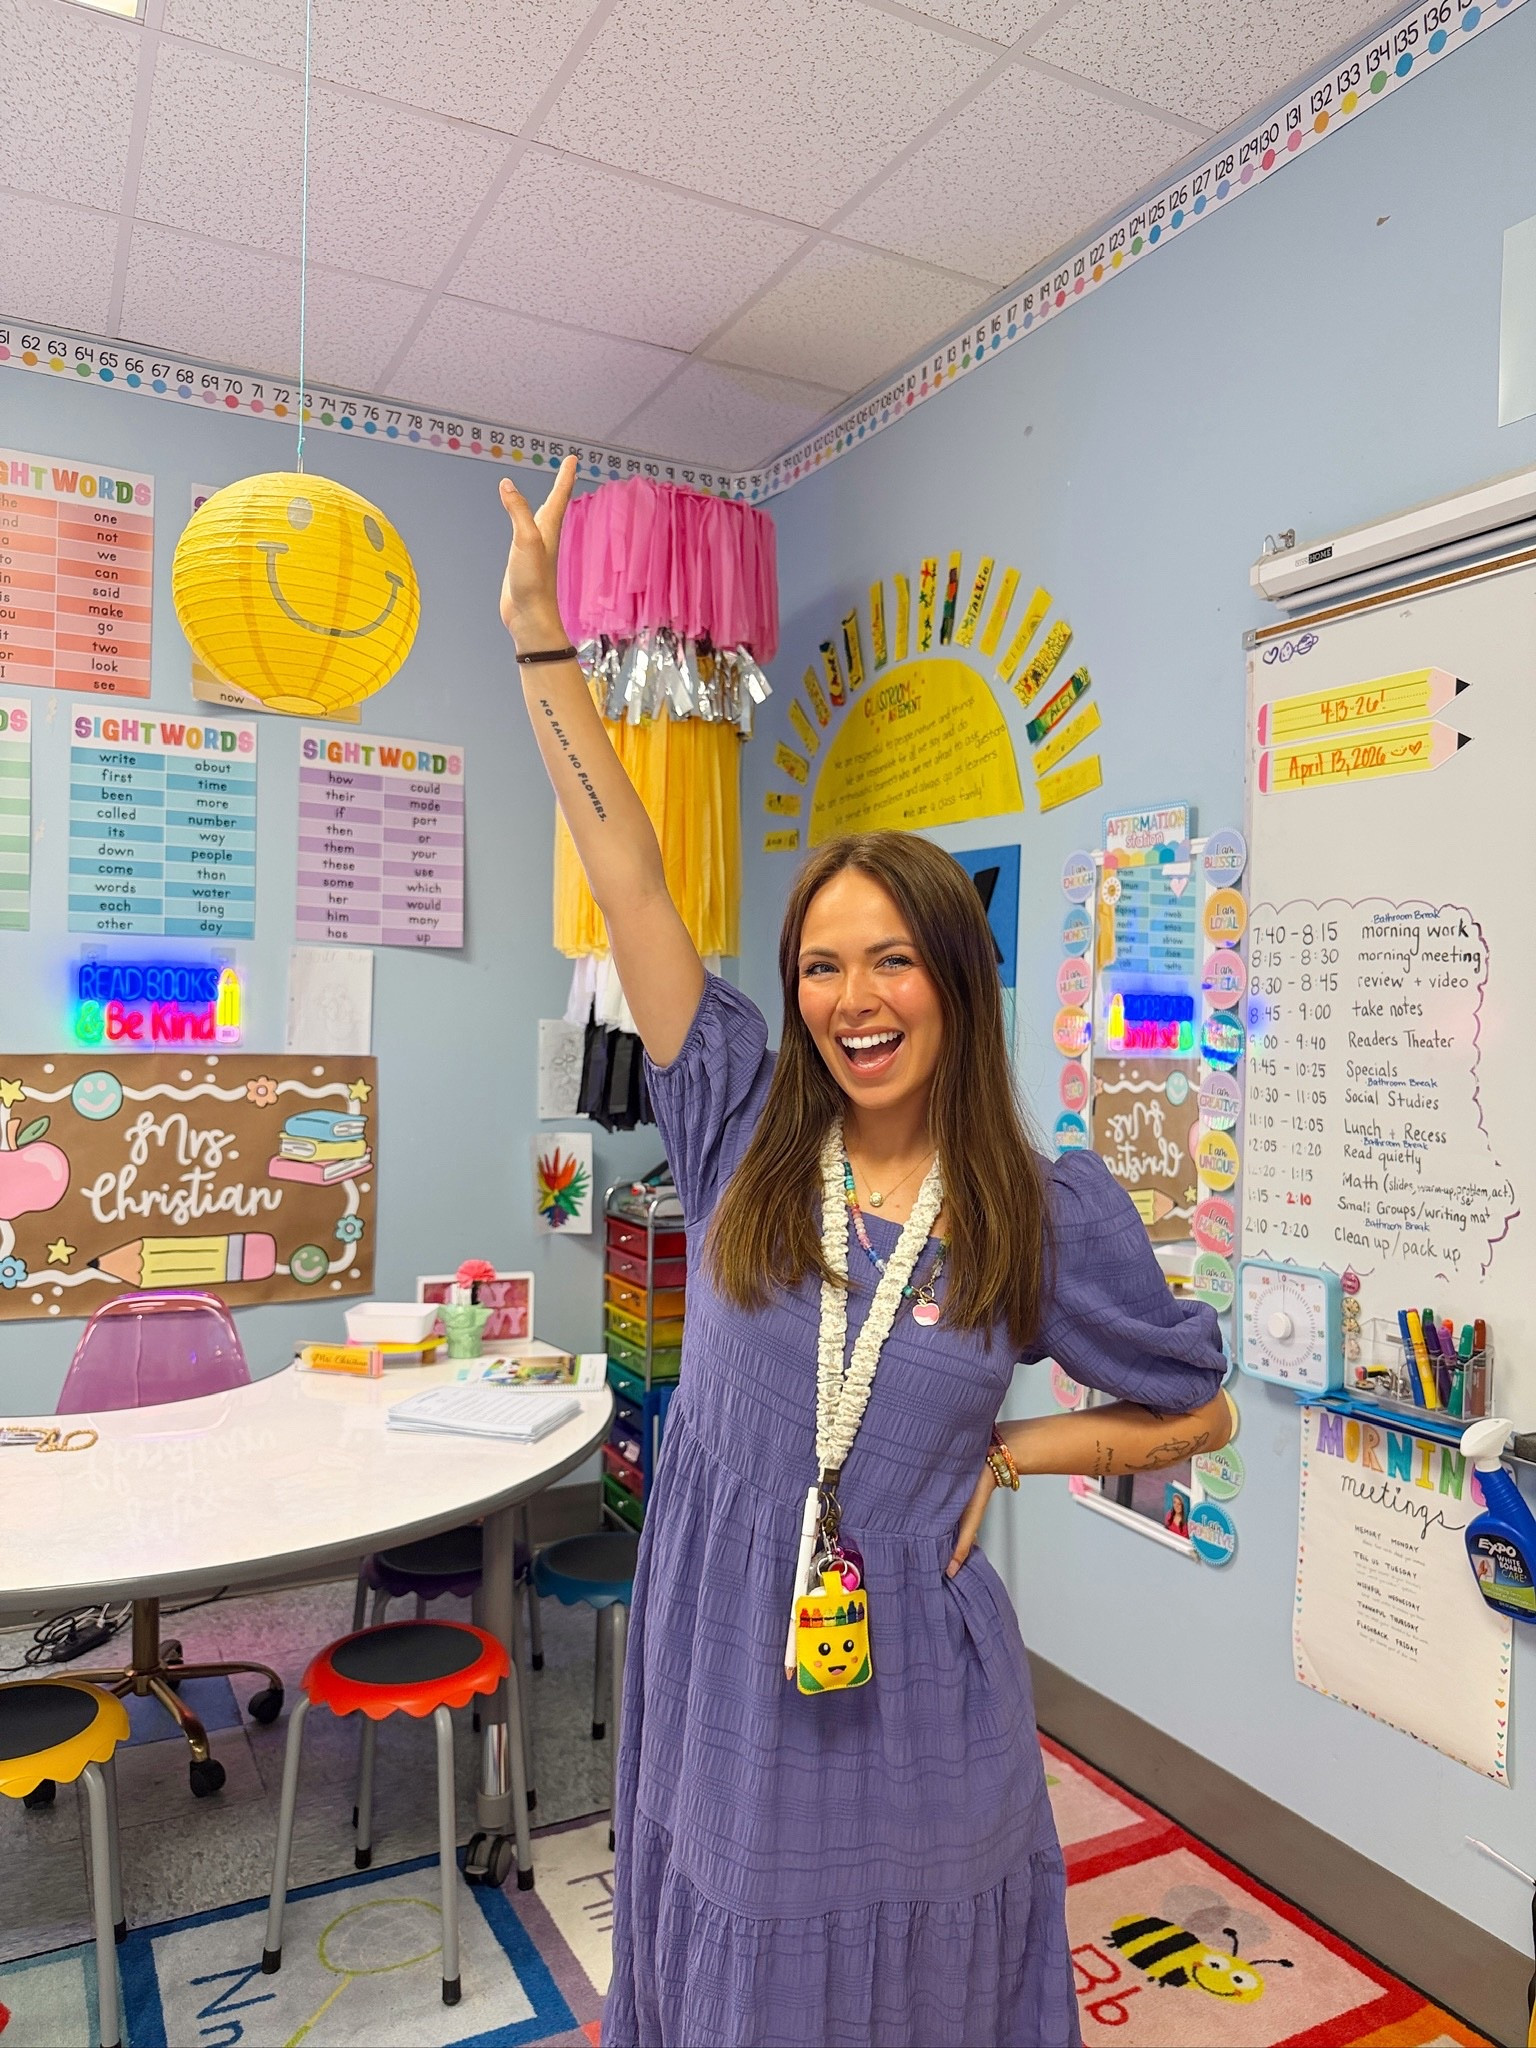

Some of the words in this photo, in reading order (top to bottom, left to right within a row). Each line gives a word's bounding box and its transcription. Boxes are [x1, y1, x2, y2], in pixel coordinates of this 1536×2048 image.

[1054, 270, 1069, 292] 120
[1109, 229, 1125, 252] 123
[1148, 199, 1165, 225] 125
[1192, 169, 1211, 196] 127
[1239, 138, 1258, 166] 129
[1286, 105, 1302, 132] 131
[1310, 83, 1332, 114] 132
[1336, 63, 1360, 95] 133
[1366, 40, 1390, 74] 134
[1394, 20, 1418, 55] 135
[21, 335, 40, 350] 62
[48, 341, 67, 357] 63
[75, 347, 94, 362] 64
[100, 352, 118, 368] 65
[152, 363, 170, 378] 67
[201, 375, 219, 390] 69
[223, 379, 242, 394] 70
[447, 424, 463, 437] 80
[52, 468, 151, 506] WORDS
[94, 513, 117, 524] one
[97, 532, 118, 543] not
[98, 551, 117, 561] we
[1309, 547, 1332, 564] HOME
[95, 569, 118, 580] can
[93, 587, 120, 599] said
[89, 605, 124, 618] make
[98, 623, 113, 635] go
[92, 642, 118, 654] two
[92, 659, 118, 672] look
[93, 681, 115, 690] see
[75, 717, 156, 744] SIGHT
[160, 722, 254, 753] WORDS
[541, 699, 553, 716] NO
[568, 754, 581, 769] NO
[99, 754, 136, 765] write
[303, 739, 375, 766] SIGHT
[379, 746, 462, 775] WORDS
[195, 760, 231, 773] about
[1289, 749, 1323, 785] April
[1331, 749, 1350, 776] 13,
[1352, 746, 1386, 768] 2026
[101, 769, 133, 782] first
[328, 771, 354, 785] how
[199, 779, 227, 791] time
[410, 784, 440, 795] could
[102, 787, 132, 800] been
[326, 790, 355, 801] their
[197, 797, 229, 809] more
[410, 800, 441, 811] made
[97, 807, 136, 820] called
[335, 807, 346, 818] if
[188, 814, 237, 828] number
[413, 816, 437, 827] part
[1107, 809, 1184, 837] AFFIRMATION
[108, 827, 125, 837] its
[327, 824, 353, 836] then
[199, 833, 225, 846] way
[418, 834, 431, 844] or
[1126, 831, 1164, 849] station
[98, 844, 134, 857] down
[324, 841, 354, 854] them
[1220, 846, 1234, 854] am
[191, 850, 233, 864] people
[411, 849, 437, 861] your
[99, 863, 133, 875] come
[323, 859, 355, 871] these
[197, 868, 226, 881] than
[415, 868, 434, 877] use
[95, 882, 136, 894] words
[323, 877, 354, 888] some
[407, 883, 442, 894] which
[192, 888, 231, 899] water
[329, 893, 348, 904] her
[100, 900, 131, 912] each
[198, 901, 224, 918] long
[407, 900, 441, 911] would
[1222, 906, 1235, 916] am
[327, 910, 349, 922] him
[409, 916, 439, 929] many
[1210, 915, 1238, 929] LOYAL
[1373, 912, 1413, 924] Bathroom
[97, 918, 133, 930] other
[200, 920, 222, 936] day
[327, 927, 348, 939] has
[417, 933, 431, 944] up
[1361, 925, 1421, 956] morning
[1427, 919, 1469, 937] work
[1358, 952, 1411, 974] morning
[1422, 946, 1481, 974] meeting
[80, 966, 143, 1000] READ
[146, 968, 218, 1001] BOOKS
[1357, 972, 1403, 988] review
[1429, 973, 1469, 988] video
[1352, 1000, 1383, 1017] take
[1390, 996, 1423, 1017] notes
[75, 1000, 102, 1043] &
[106, 1000, 144, 1040] Be
[151, 1000, 216, 1041] Kind
[1348, 1032, 1398, 1049] Readers
[1403, 1029, 1454, 1049] Theater
[1346, 1060, 1398, 1080] Specials
[1367, 1078, 1406, 1087] Bathroom
[1409, 1079, 1438, 1087] Break
[1345, 1089, 1379, 1104] Social
[1388, 1091, 1439, 1110] Studies
[1344, 1119, 1381, 1138] Lunch
[1405, 1127, 1447, 1144] Recess
[125, 1110, 240, 1168] Mrs.
[1214, 1146, 1227, 1156] am
[1200, 1156, 1236, 1175] UNIQUE
[1344, 1145, 1372, 1159] Read
[1379, 1150, 1422, 1174] quietly
[1343, 1172, 1378, 1190] Math
[80, 1164, 283, 1226] Christian
[1335, 1227, 1369, 1248] Clean
[1443, 1248, 1460, 1265] up
[1341, 1474, 1465, 1540] meetings
[1391, 1538, 1419, 1552] MONDAY
[1478, 1538, 1516, 1558] EXPO
[1496, 1555, 1520, 1566] WHITE
[1502, 1570, 1524, 1582] CARE
